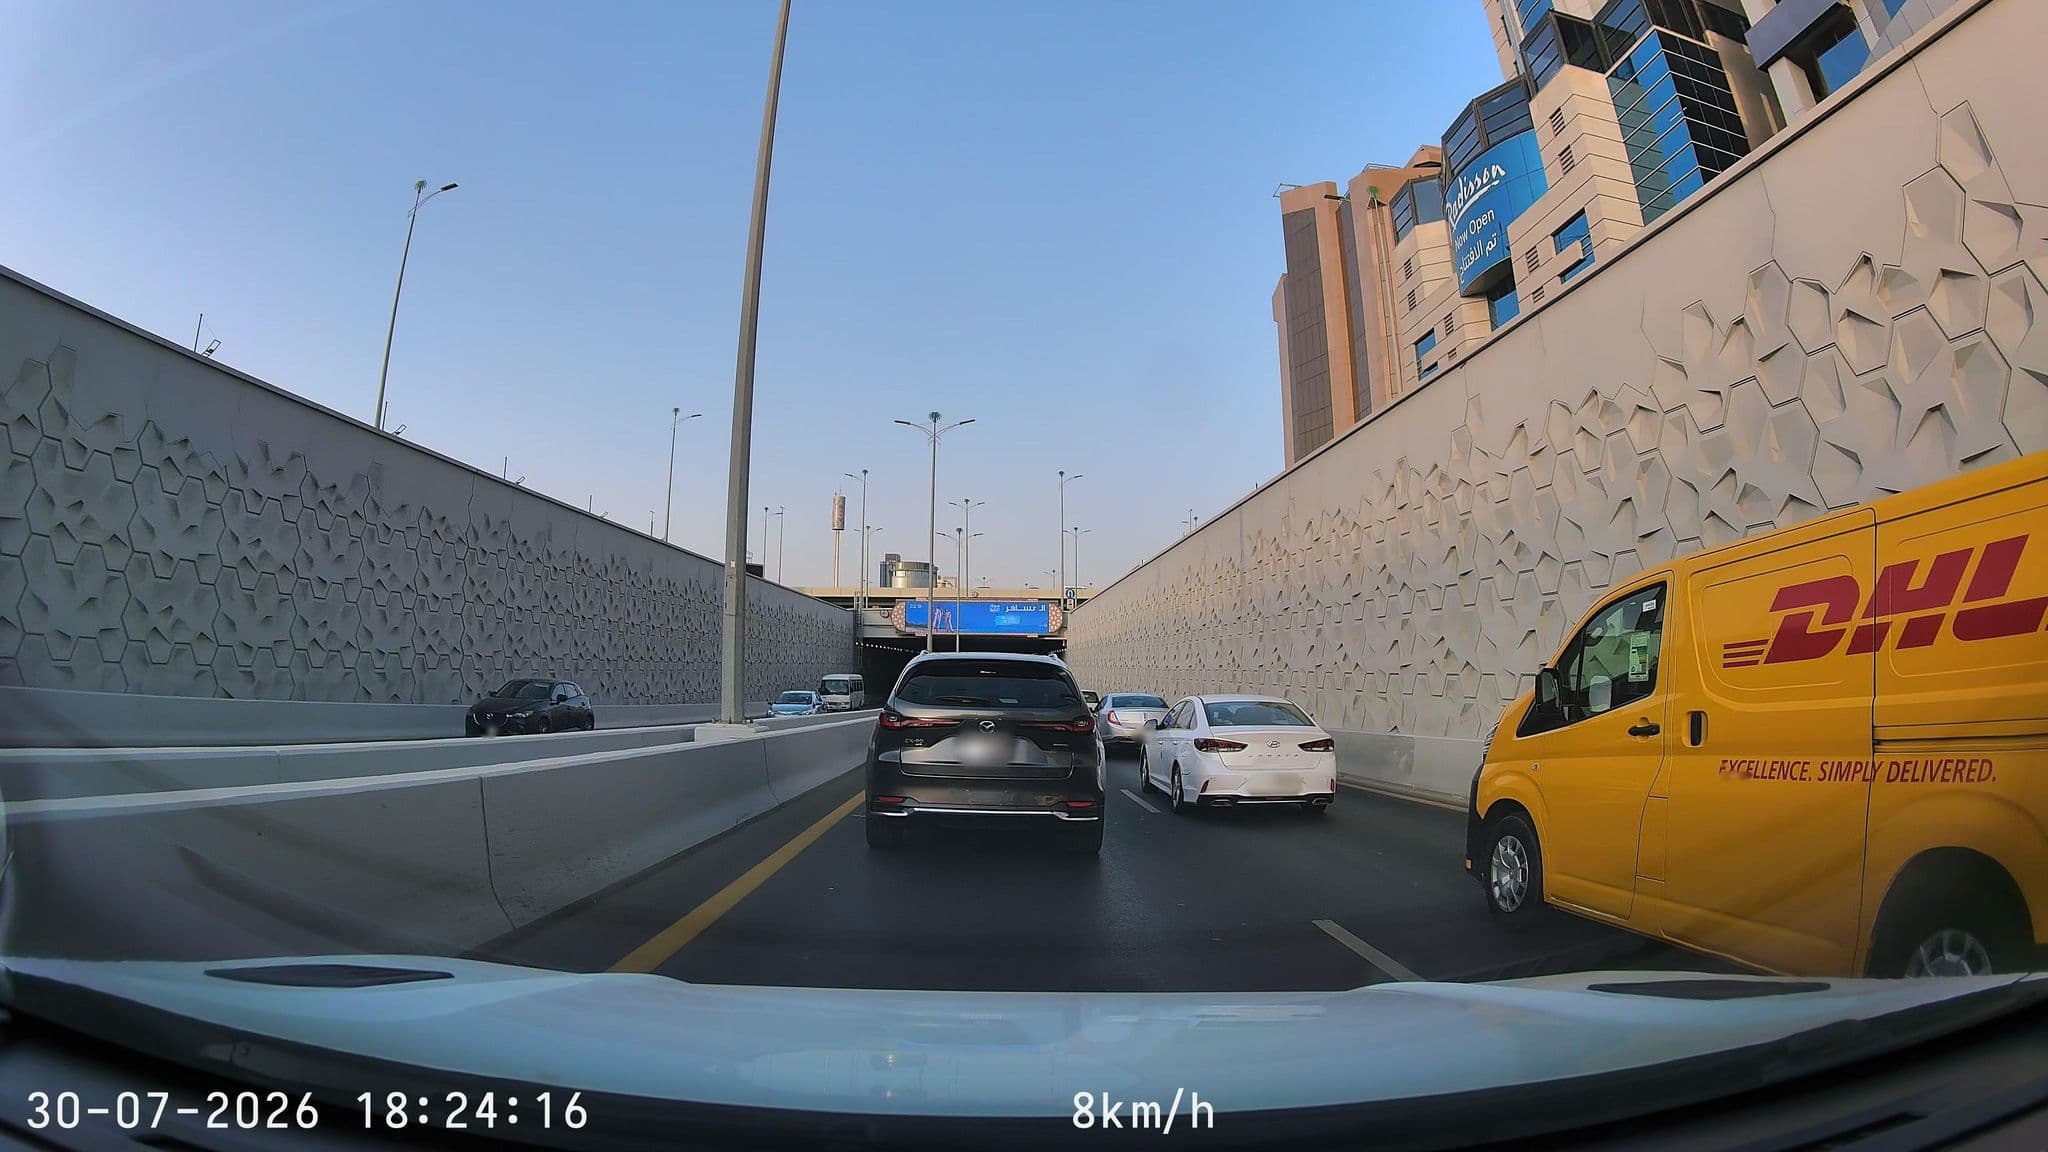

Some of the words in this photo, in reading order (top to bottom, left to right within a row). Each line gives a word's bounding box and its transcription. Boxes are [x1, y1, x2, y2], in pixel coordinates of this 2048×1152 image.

[1446, 164, 1506, 232] Radisson
[1454, 229, 1468, 252] Now
[1469, 209, 1495, 234] Open
[1485, 232, 1498, 256] تم
[1763, 534, 2048, 665] DHL
[1718, 759, 1812, 782] EXCELLENCE.
[1817, 760, 1884, 783] SIMPLY
[1886, 758, 1997, 783] DELIVERED.
